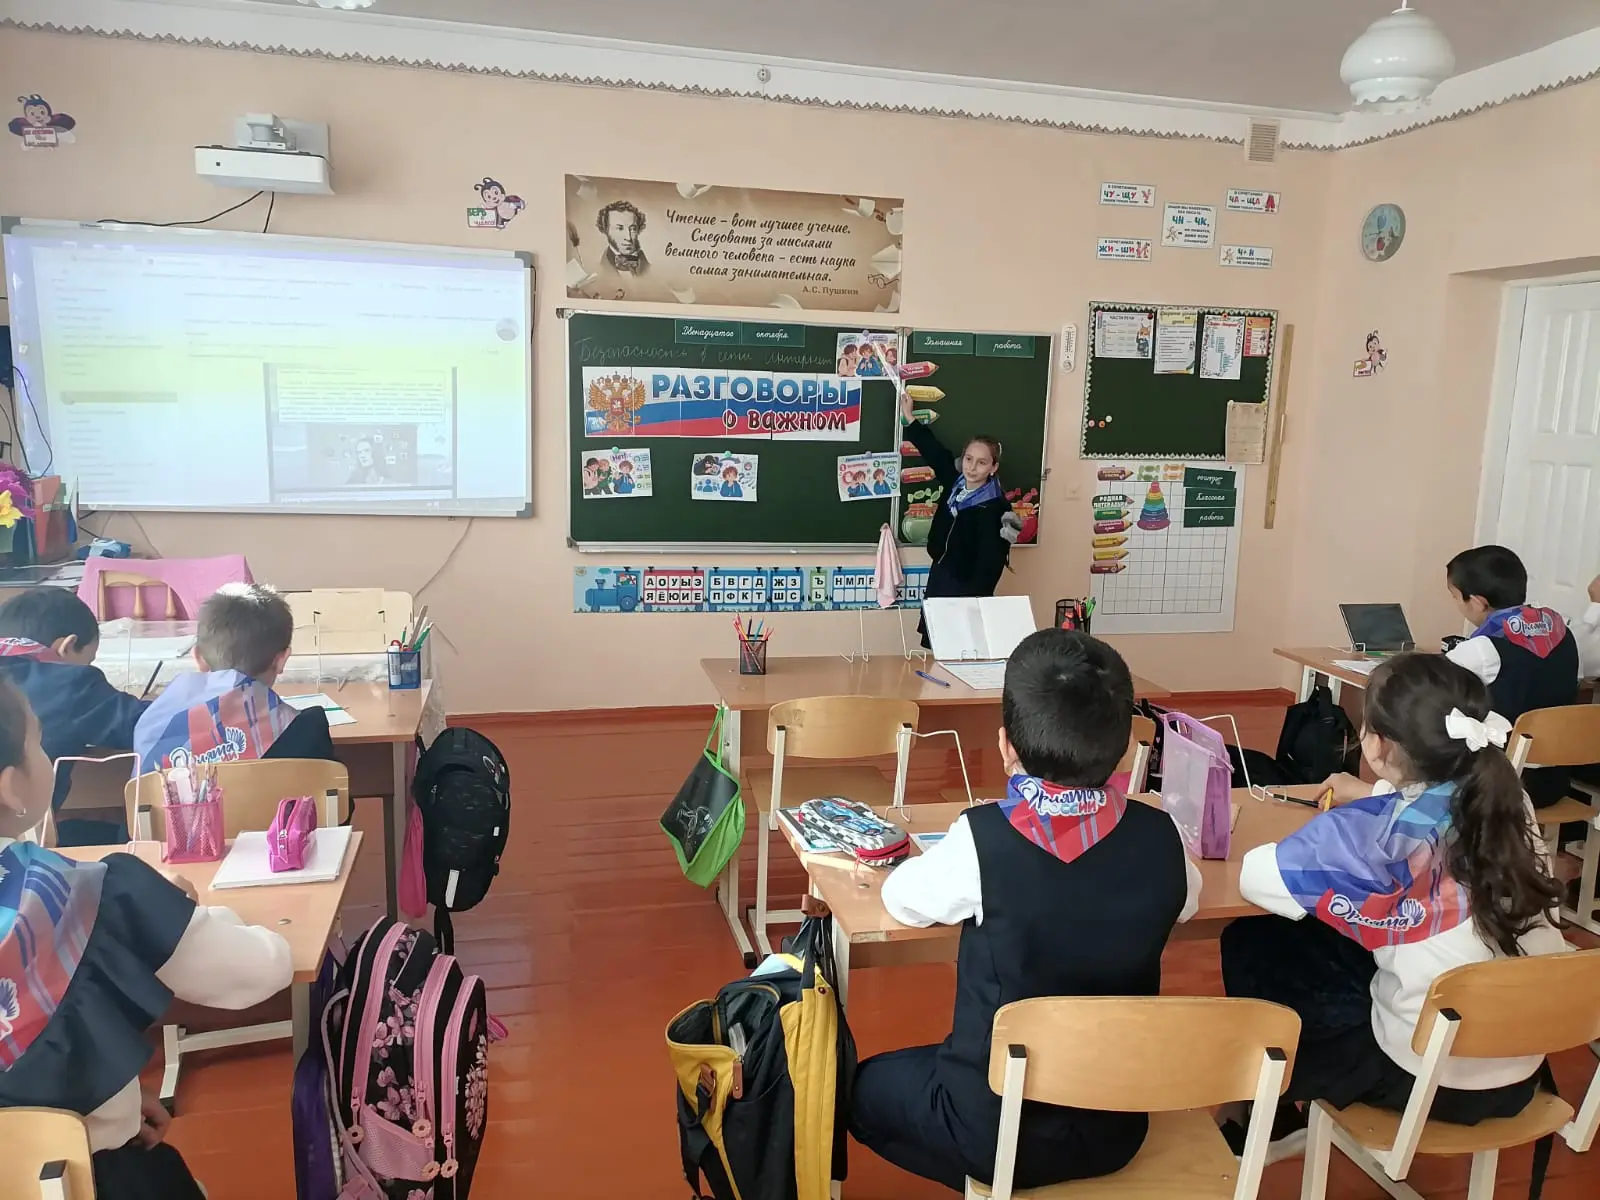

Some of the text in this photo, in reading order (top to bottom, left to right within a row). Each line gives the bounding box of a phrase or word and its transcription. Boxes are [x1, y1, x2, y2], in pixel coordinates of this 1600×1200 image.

[1104, 190, 1115, 198] ЧУ
[1122, 191, 1136, 200] ЩУ
[1229, 195, 1239, 203] ЧА
[1247, 197, 1260, 205] ЩА
[667, 209, 716, 226] Чтение
[732, 213, 757, 228] вот
[760, 219, 803, 234] лучшее
[807, 221, 851, 236] учение.
[1172, 215, 1184, 224] ЧН
[691, 228, 757, 247] Следовать
[759, 238, 772, 250] за
[665, 242, 718, 259] великого
[723, 247, 774, 263] человека
[790, 254, 817, 265] есть
[820, 257, 856, 270] наука
[690, 265, 831, 282] самая занимательная.
[823, 286, 858, 297] Пушкин
[682, 326, 790, 342] Двенадцатое октября
[924, 336, 1022, 352] Домашняя работа
[652, 374, 848, 405] РАЗГОВОРЫ
[1198, 512, 1224, 524] работа
